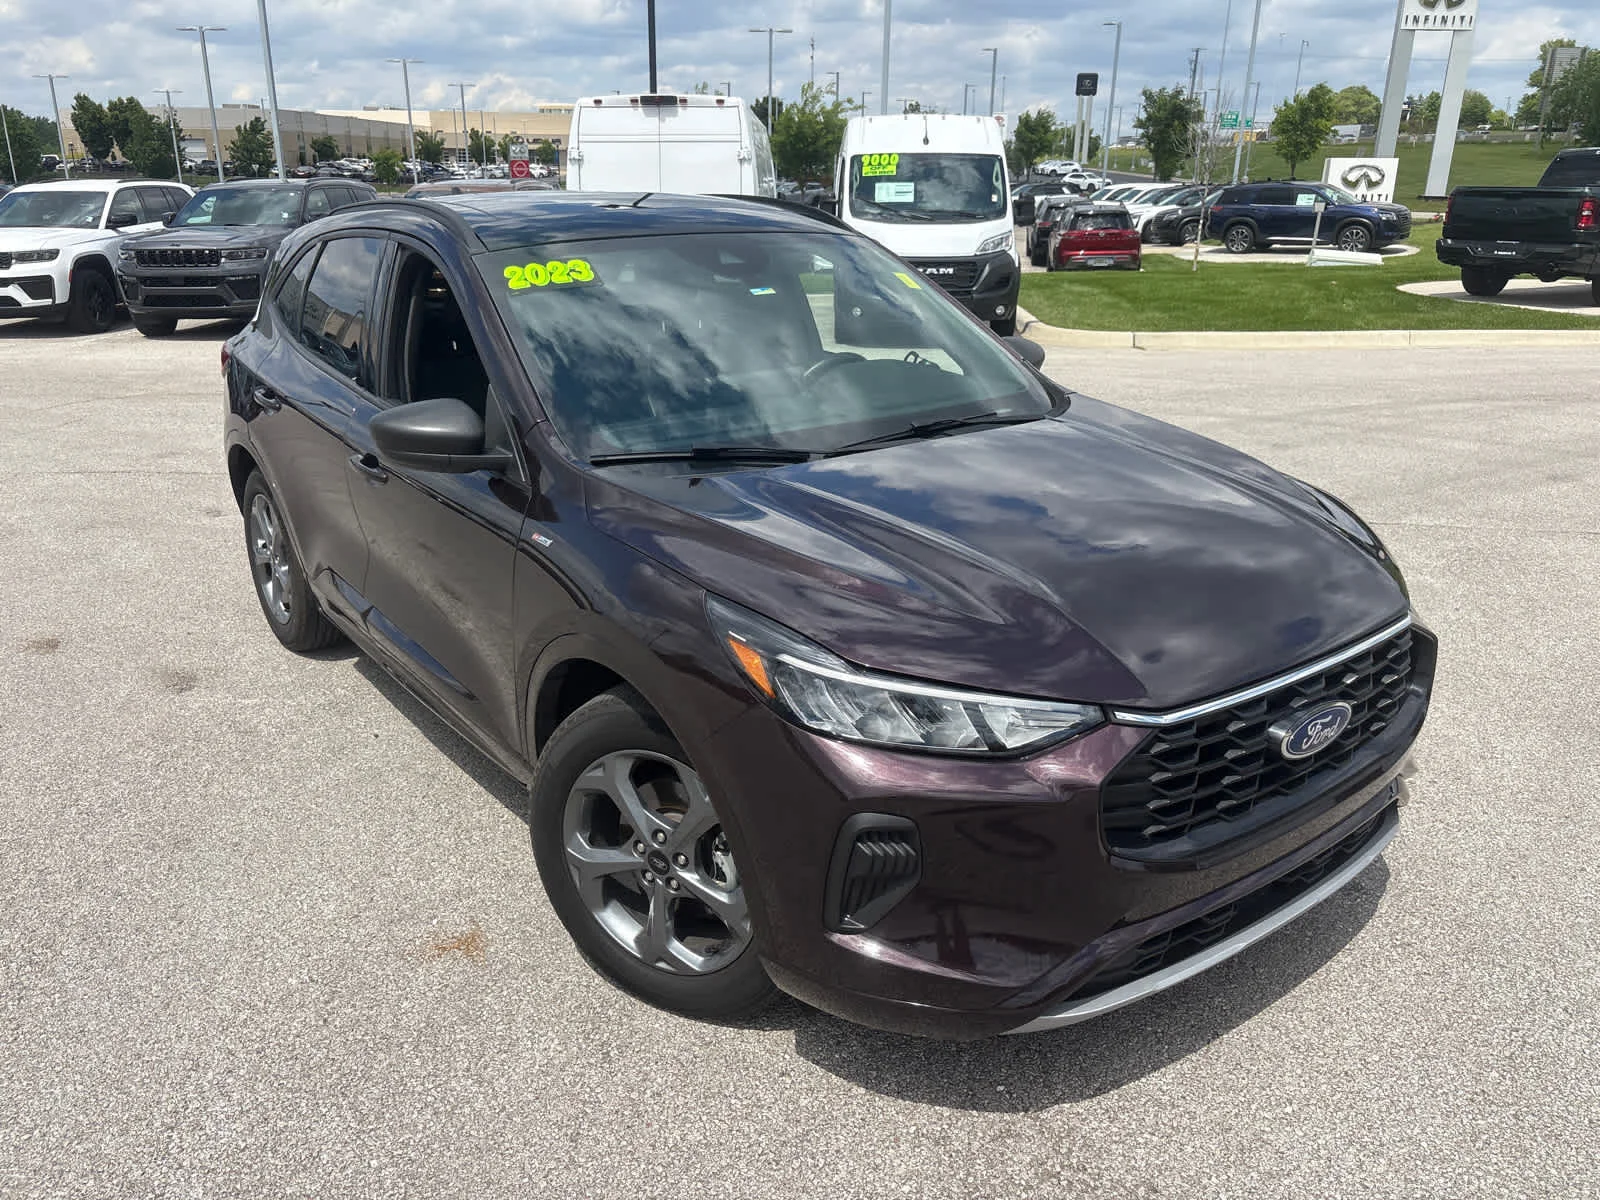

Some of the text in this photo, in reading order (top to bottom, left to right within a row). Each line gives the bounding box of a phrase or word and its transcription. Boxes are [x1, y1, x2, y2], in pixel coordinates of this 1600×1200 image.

[1404, 14, 1473, 26] INFINITI
[861, 153, 899, 166] 9000
[1354, 193, 1389, 202] INITI
[503, 259, 595, 290] 2023
[1301, 714, 1341, 750] Ford
